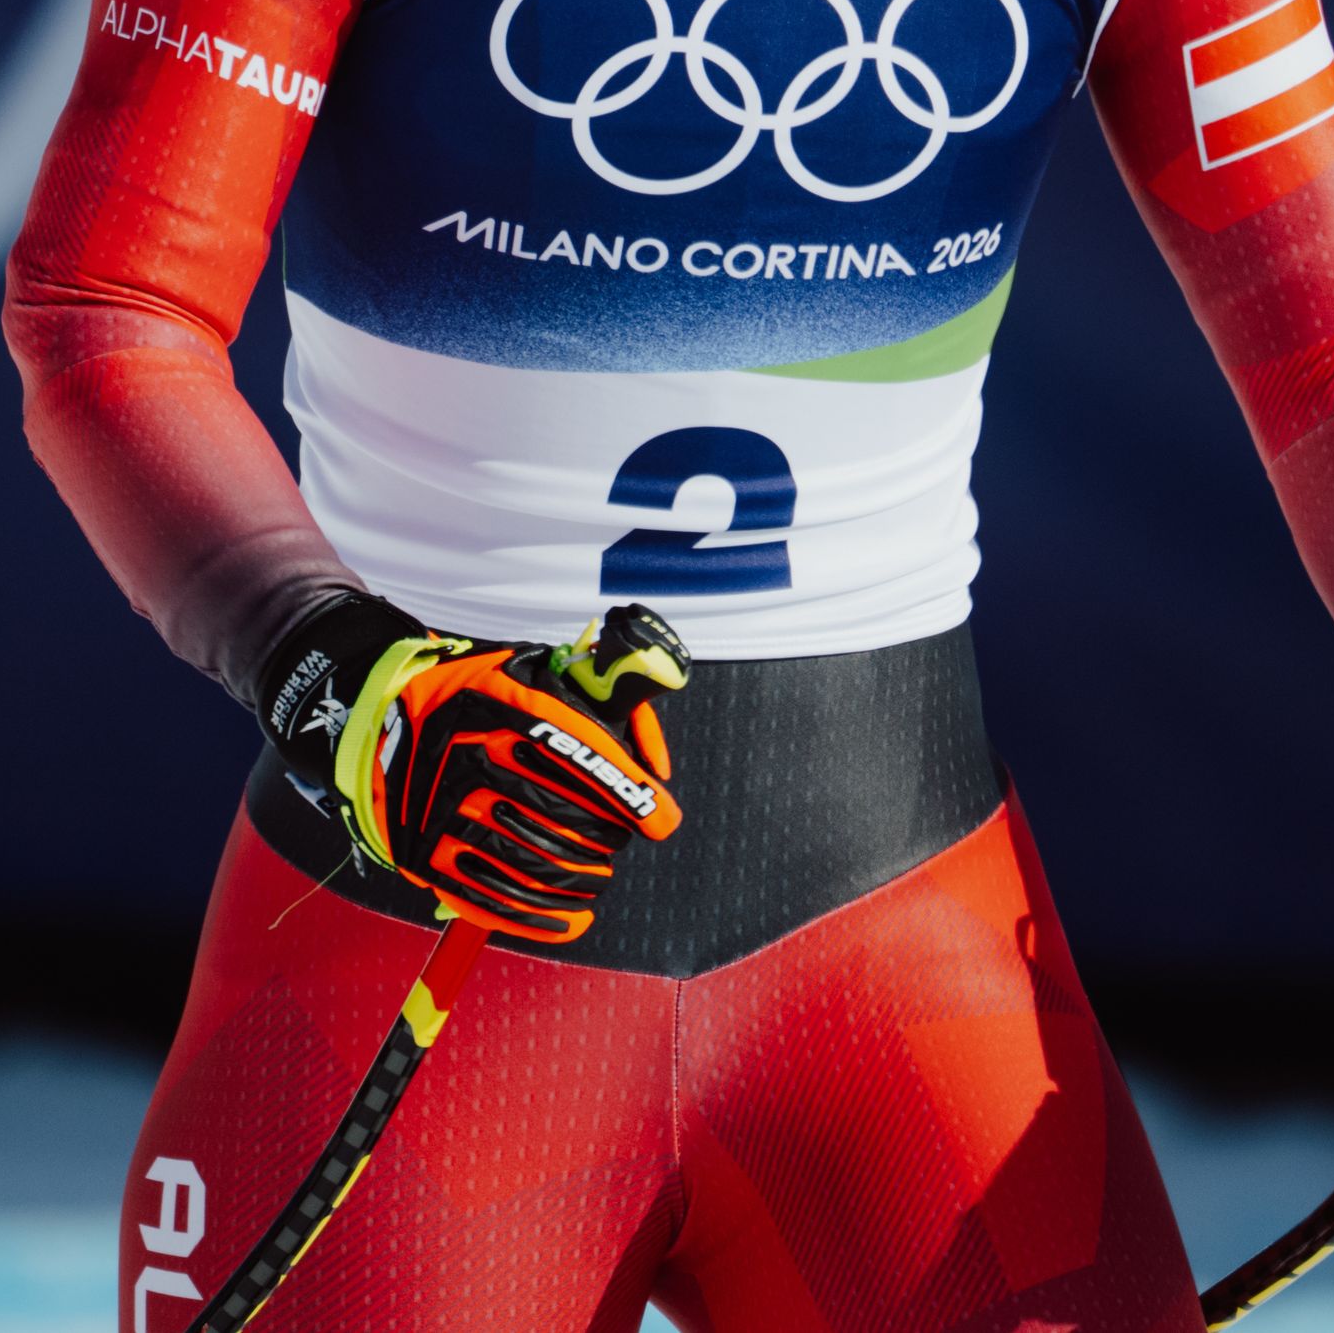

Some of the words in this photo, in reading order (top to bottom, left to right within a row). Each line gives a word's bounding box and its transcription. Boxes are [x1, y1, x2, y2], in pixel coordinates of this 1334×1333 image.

[422, 211, 669, 274] MILANO
[681, 241, 916, 281] CORTINA
[927, 223, 1004, 275] 2026
[599, 426, 798, 597] 2
[528, 721, 657, 817] reusch
